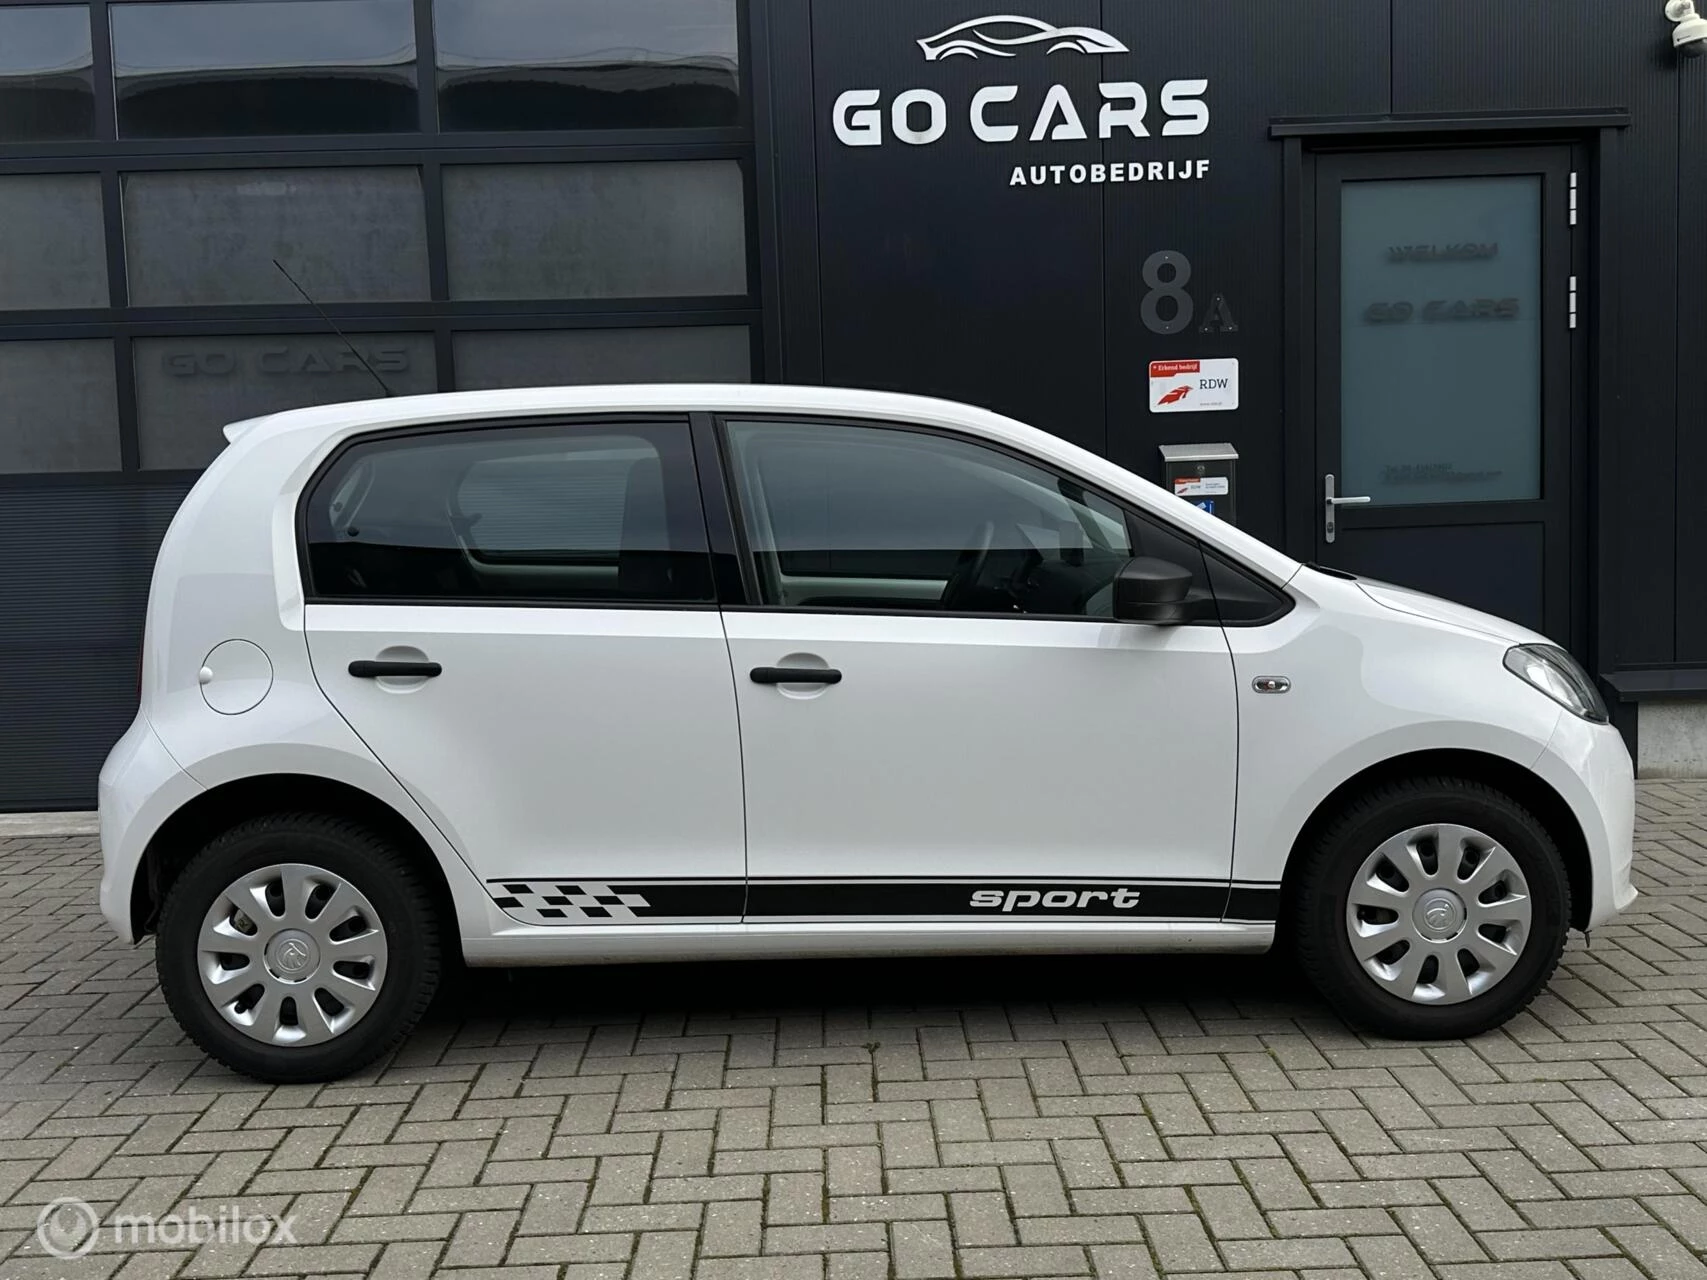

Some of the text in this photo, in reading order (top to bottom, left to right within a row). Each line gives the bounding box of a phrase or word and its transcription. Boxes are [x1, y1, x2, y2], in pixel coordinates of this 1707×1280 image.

[833, 79, 1209, 146] GO CARS
[1009, 159, 1210, 186] AUTOBEDRIJF
[1364, 298, 1519, 324] GO CARS
[162, 346, 409, 376] GO CARS
[1200, 378, 1228, 389] RDW
[970, 888, 1140, 912] sport
